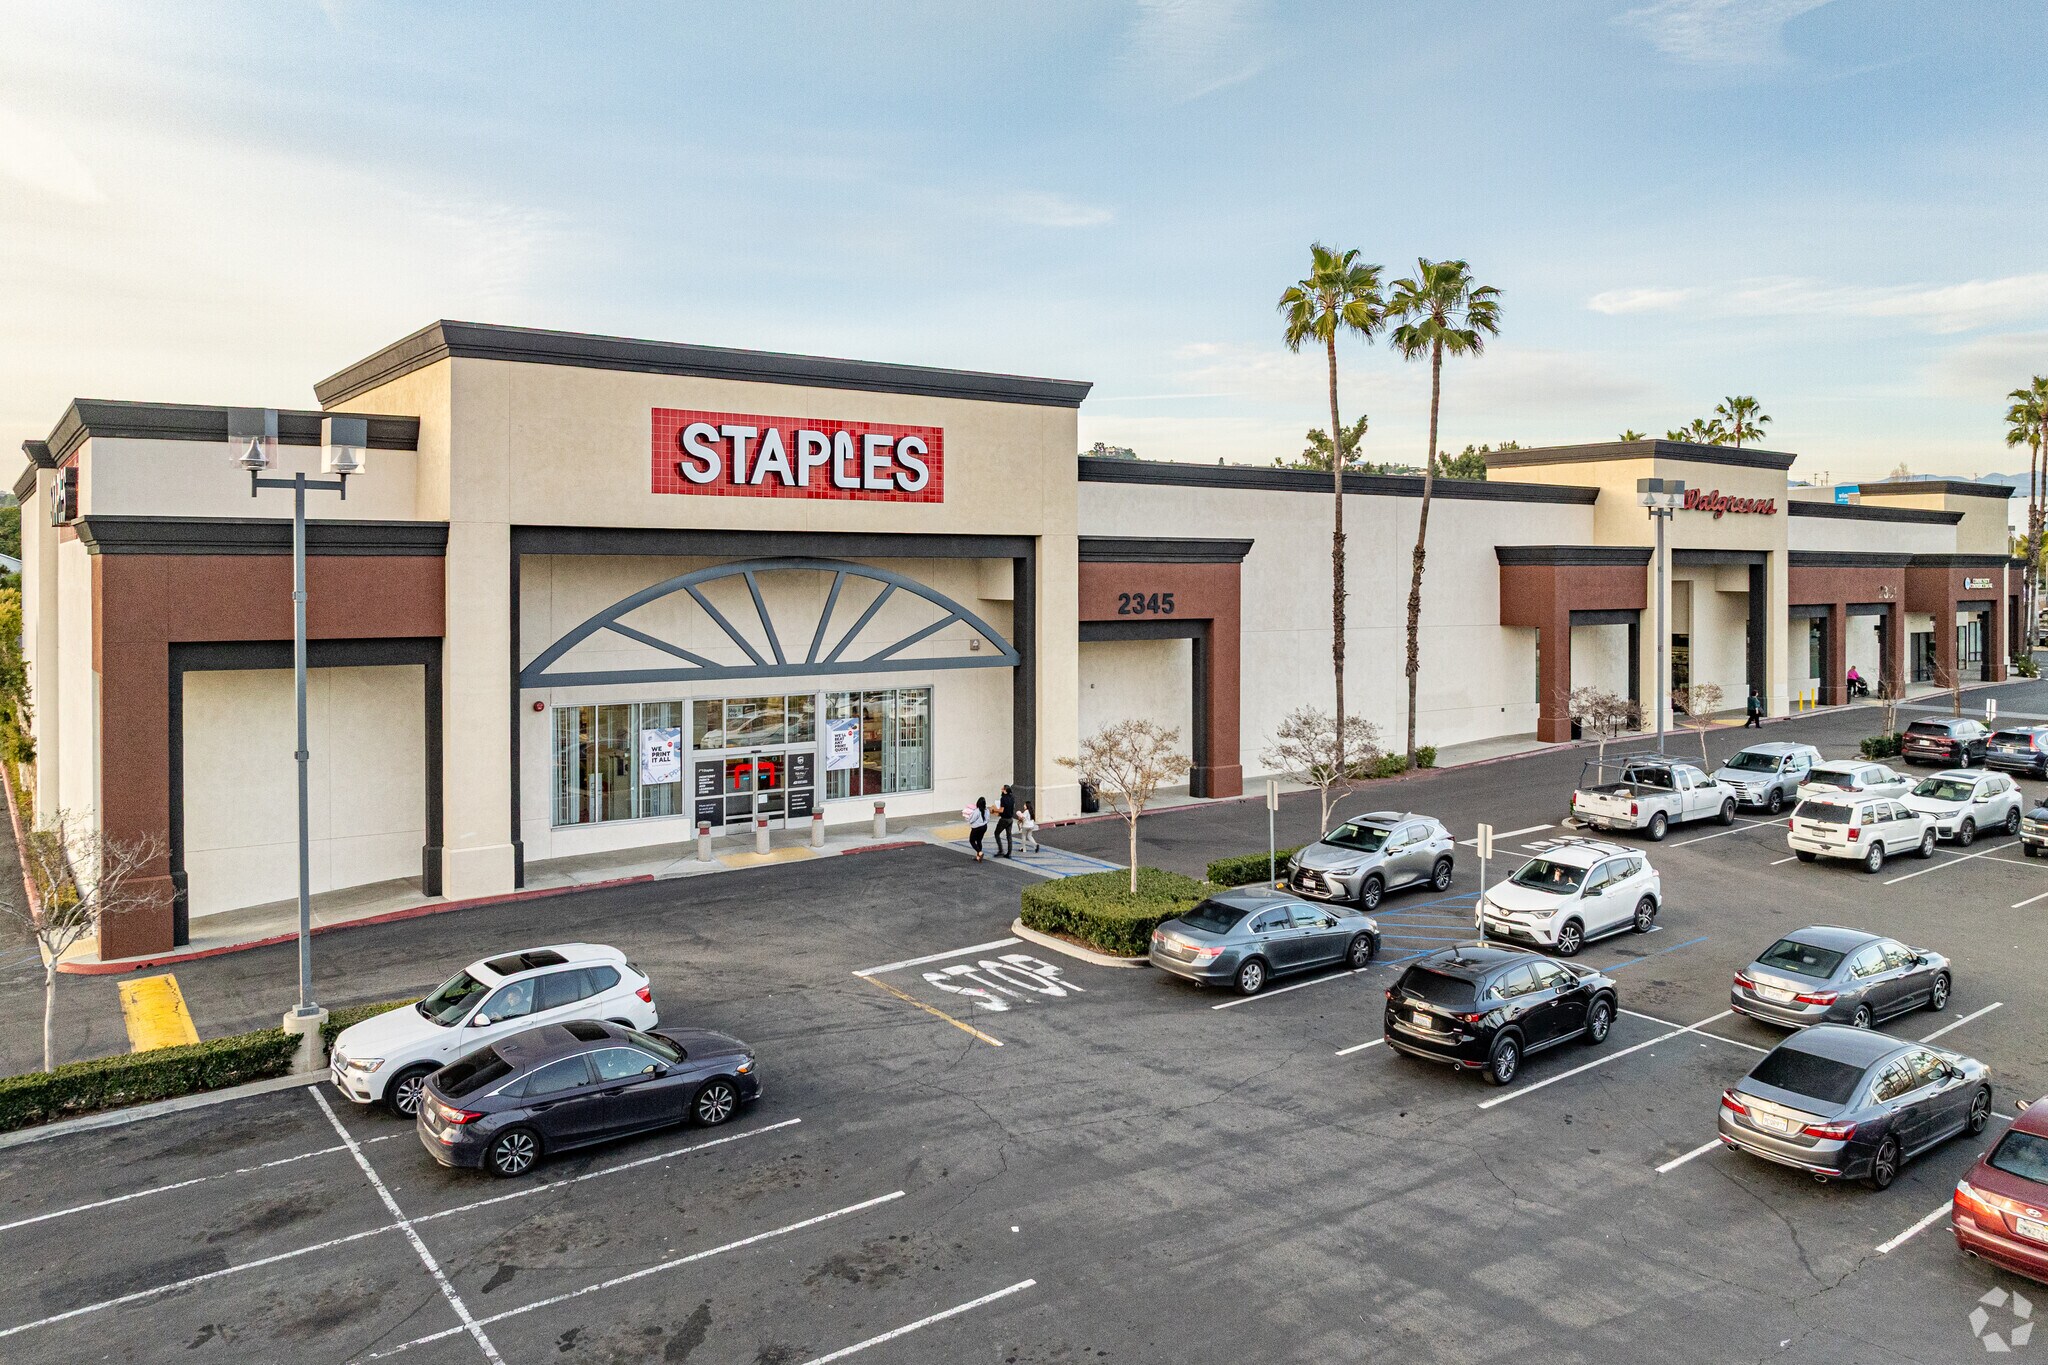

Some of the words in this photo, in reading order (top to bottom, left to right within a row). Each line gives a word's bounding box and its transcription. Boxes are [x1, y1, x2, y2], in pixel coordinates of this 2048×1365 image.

[681, 422, 930, 492] STAPLES
[1684, 488, 1778, 519] Walgreens
[1118, 593, 1175, 614] 2345
[922, 954, 1087, 1011] STOP
